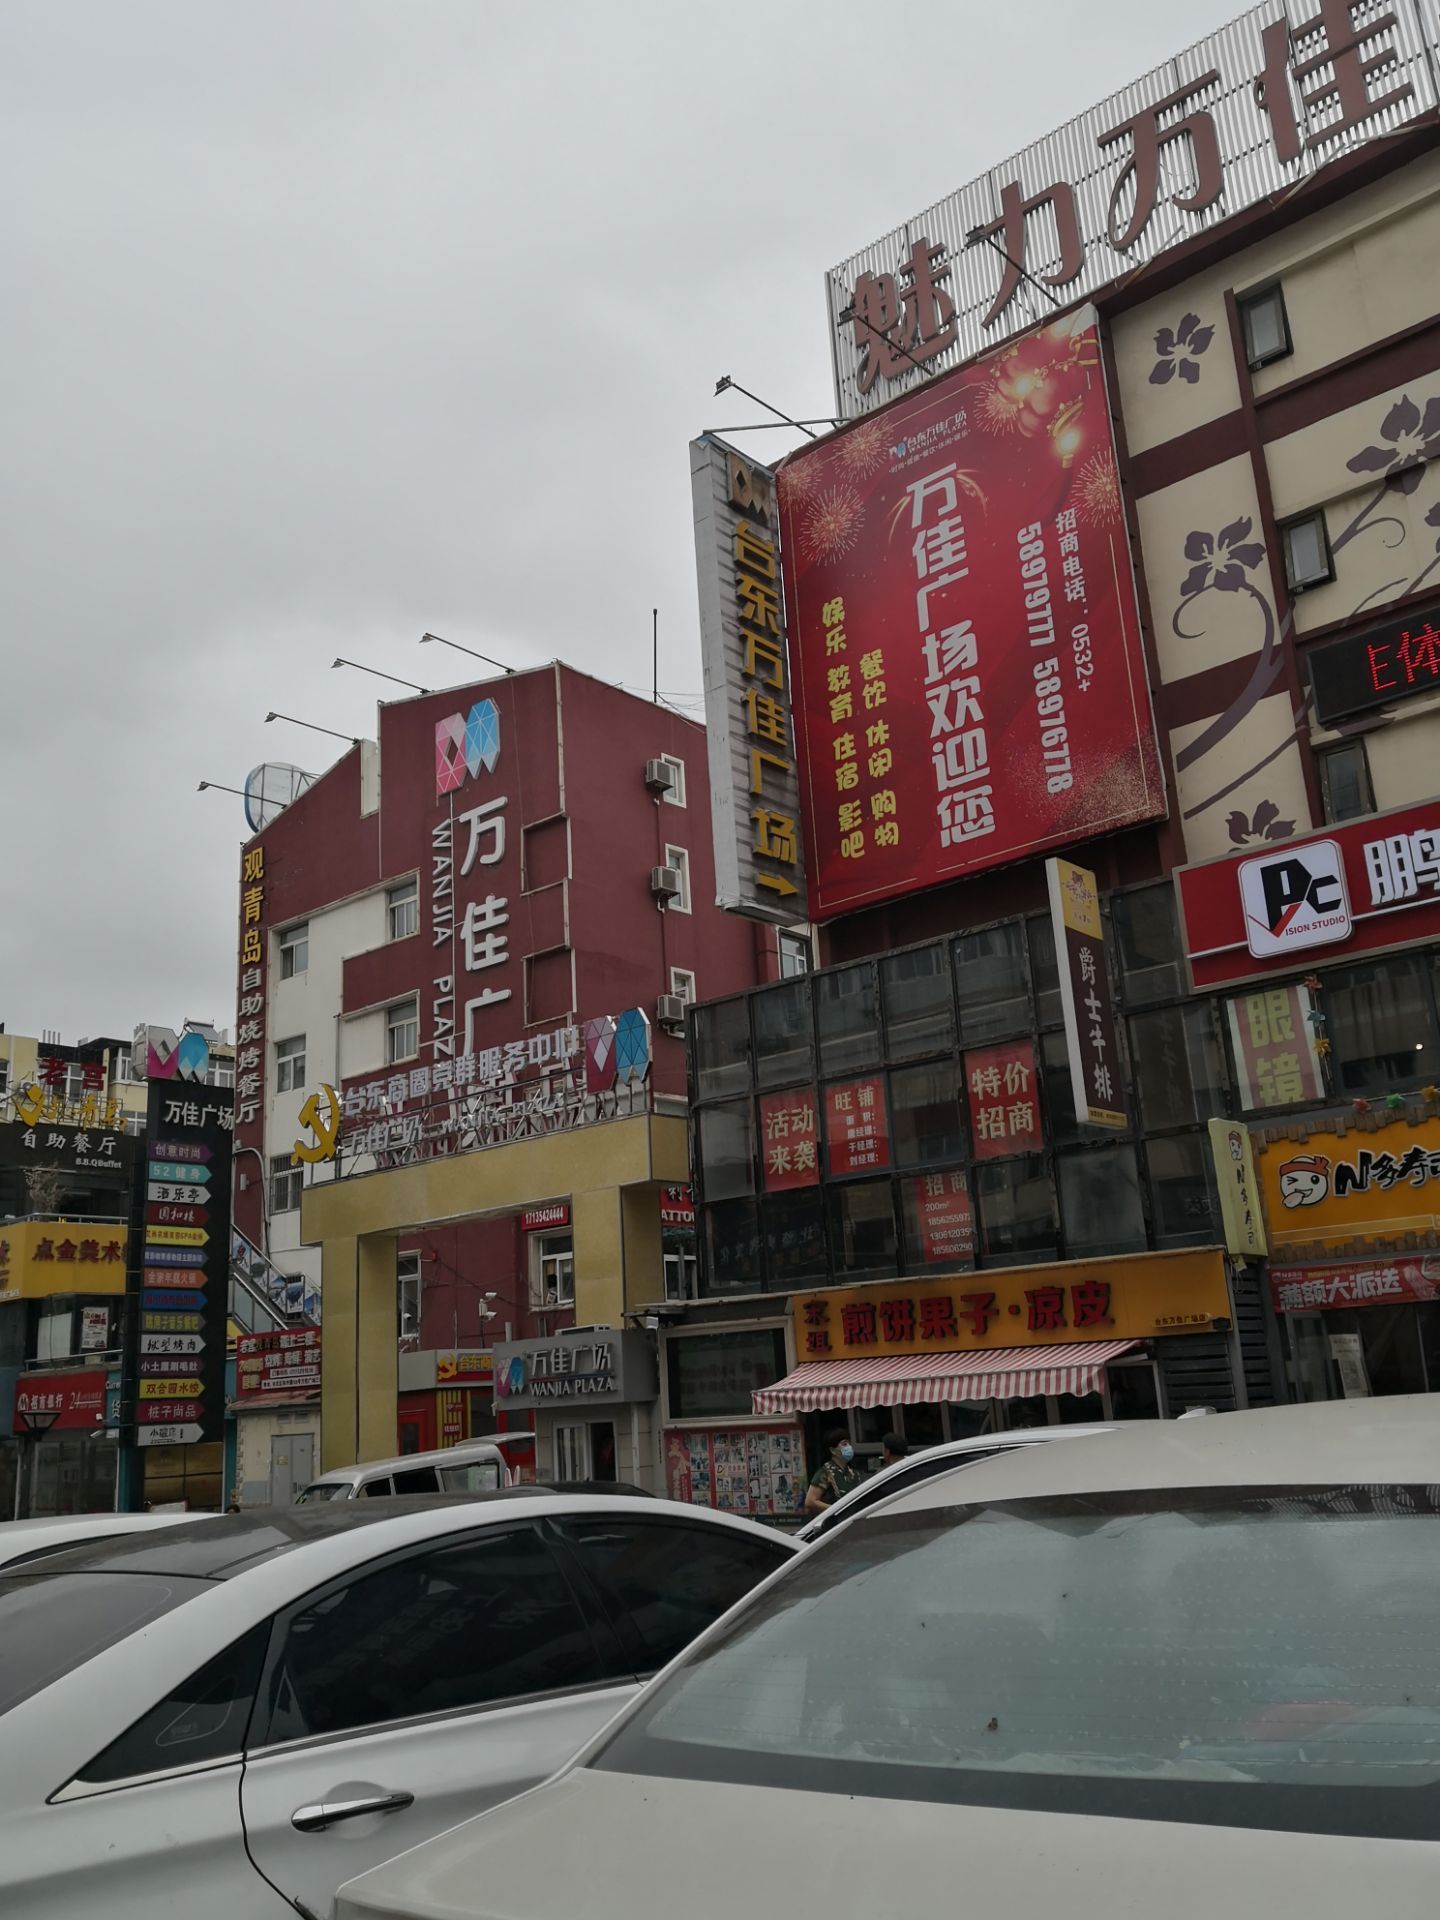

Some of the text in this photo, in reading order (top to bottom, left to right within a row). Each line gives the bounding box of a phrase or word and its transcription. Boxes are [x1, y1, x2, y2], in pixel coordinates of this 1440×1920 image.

[845, 0, 1416, 395] 魅力万佳
[906, 463, 996, 848] 万佳广场欢迎您
[1017, 521, 1074, 794] 58979777 58976778
[1070, 623, 1094, 693] 0532+
[730, 519, 799, 866] 台东万佳广场
[871, 789, 899, 847] 购物
[432, 818, 456, 1062] WANJIA PLAZ
[1312, 914, 1346, 931] STUDIO
[1079, 947, 1114, 1103] 爵士牛排
[1246, 986, 1305, 1104] 眼镜
[344, 1025, 580, 1116] 台东商圈党群服务中心
[971, 1061, 1030, 1100] 特价
[164, 1099, 234, 1130] 万佳广场
[766, 1104, 814, 1140] 活动
[976, 1101, 1034, 1141] 招商
[21, 1128, 117, 1156] 自助餐厅
[155, 1144, 201, 1159] 创意时尚
[769, 1141, 816, 1175] 来袭
[925, 1171, 967, 1197] 招商
[661, 1208, 695, 1223] ATTO
[1278, 1267, 1403, 1311] 满额大派送
[531, 1343, 612, 1377] 万佳广场
[529, 1376, 614, 1398] WANJIA PLAZA
